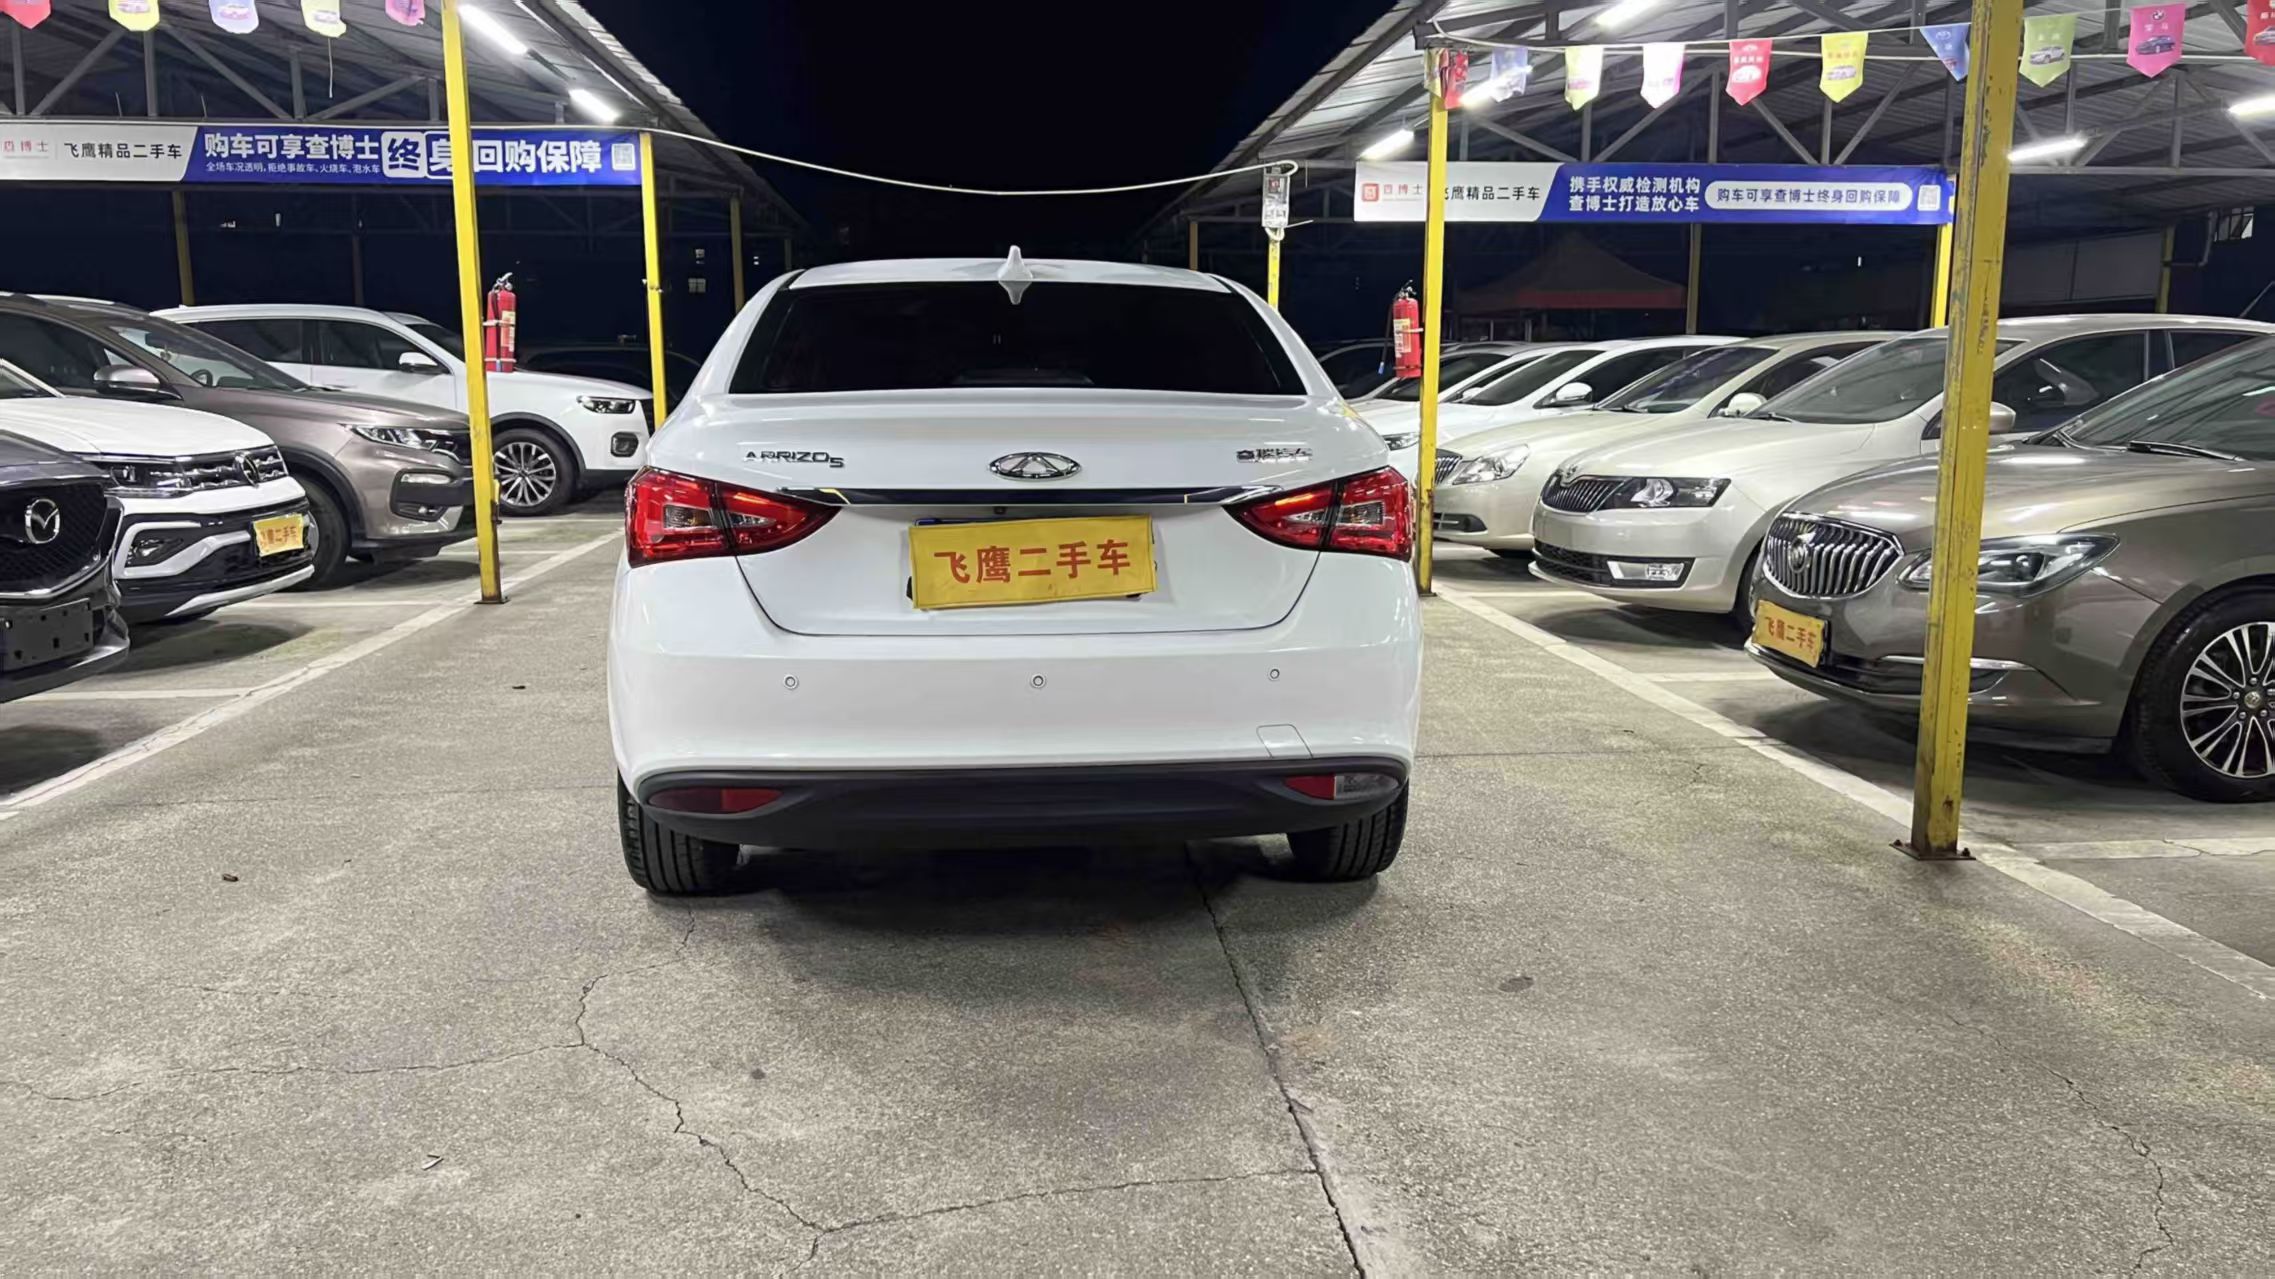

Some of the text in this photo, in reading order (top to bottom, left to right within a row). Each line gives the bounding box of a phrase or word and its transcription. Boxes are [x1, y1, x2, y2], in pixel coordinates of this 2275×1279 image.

[64, 142, 182, 159] 飞鹰精品二手车
[204, 133, 380, 160] 购车可享查博士
[1444, 186, 1541, 201] 鹰精品二手车
[1569, 176, 1701, 194] 携手权威检测机构
[1569, 195, 1700, 213] 查博士打造放心车
[1717, 187, 1901, 204] 购车可享查博士终身回购保障
[934, 539, 1131, 584] 飞鹰二手车
